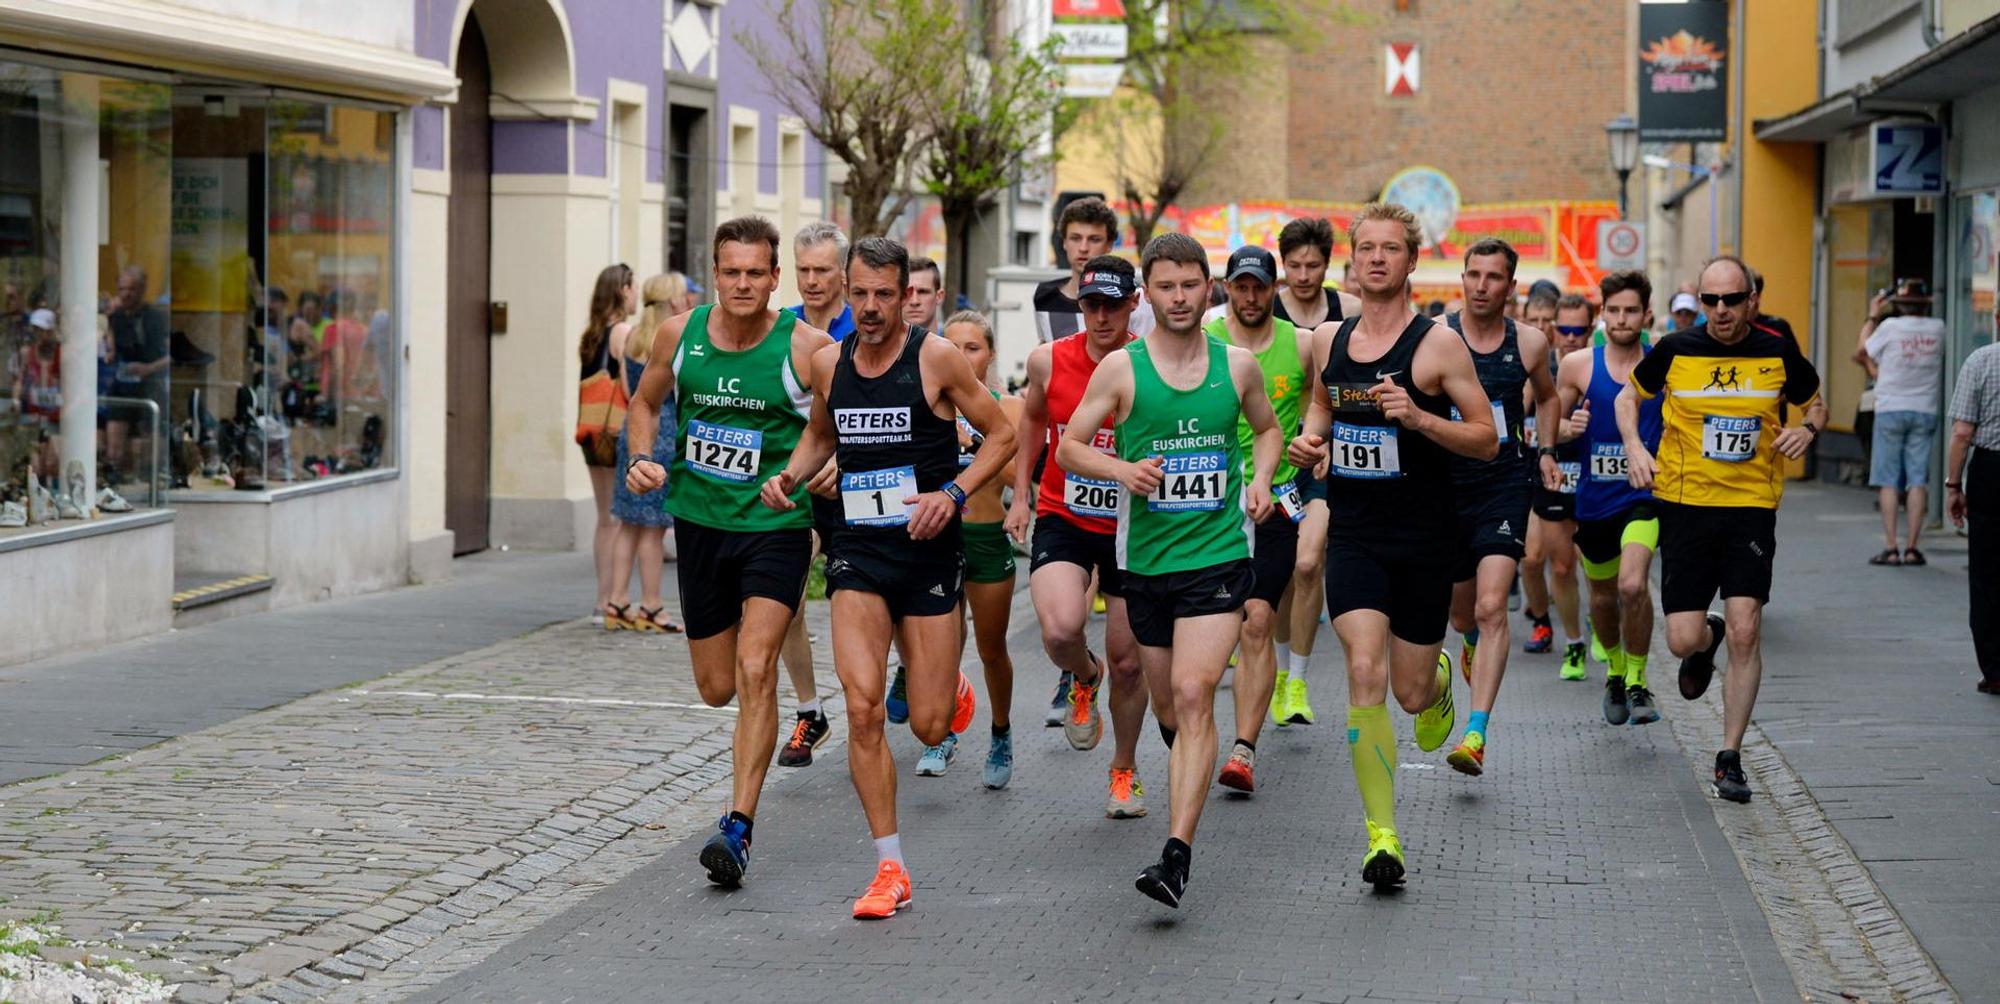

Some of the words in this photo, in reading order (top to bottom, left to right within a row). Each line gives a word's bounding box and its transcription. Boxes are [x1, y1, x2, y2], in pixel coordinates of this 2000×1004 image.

[718, 377, 741, 393] LC
[693, 394, 765, 411] EUSKIRCHEN
[838, 412, 908, 429] PETERS
[1178, 418, 1200, 435] LC
[1711, 417, 1756, 430] PETERS
[696, 425, 753, 446] PETERS
[1152, 434, 1225, 451] EUSKIRCHEN
[1338, 426, 1388, 443] PETERS
[1715, 432, 1751, 453] 175
[692, 440, 753, 473] 1274
[1341, 443, 1382, 469] 191
[1597, 445, 1628, 455] PETE
[1160, 456, 1219, 471] PETERS
[850, 471, 905, 488] PETERS
[1158, 472, 1220, 500] 1441
[871, 491, 885, 515] 1
[1074, 485, 1119, 509] 206
